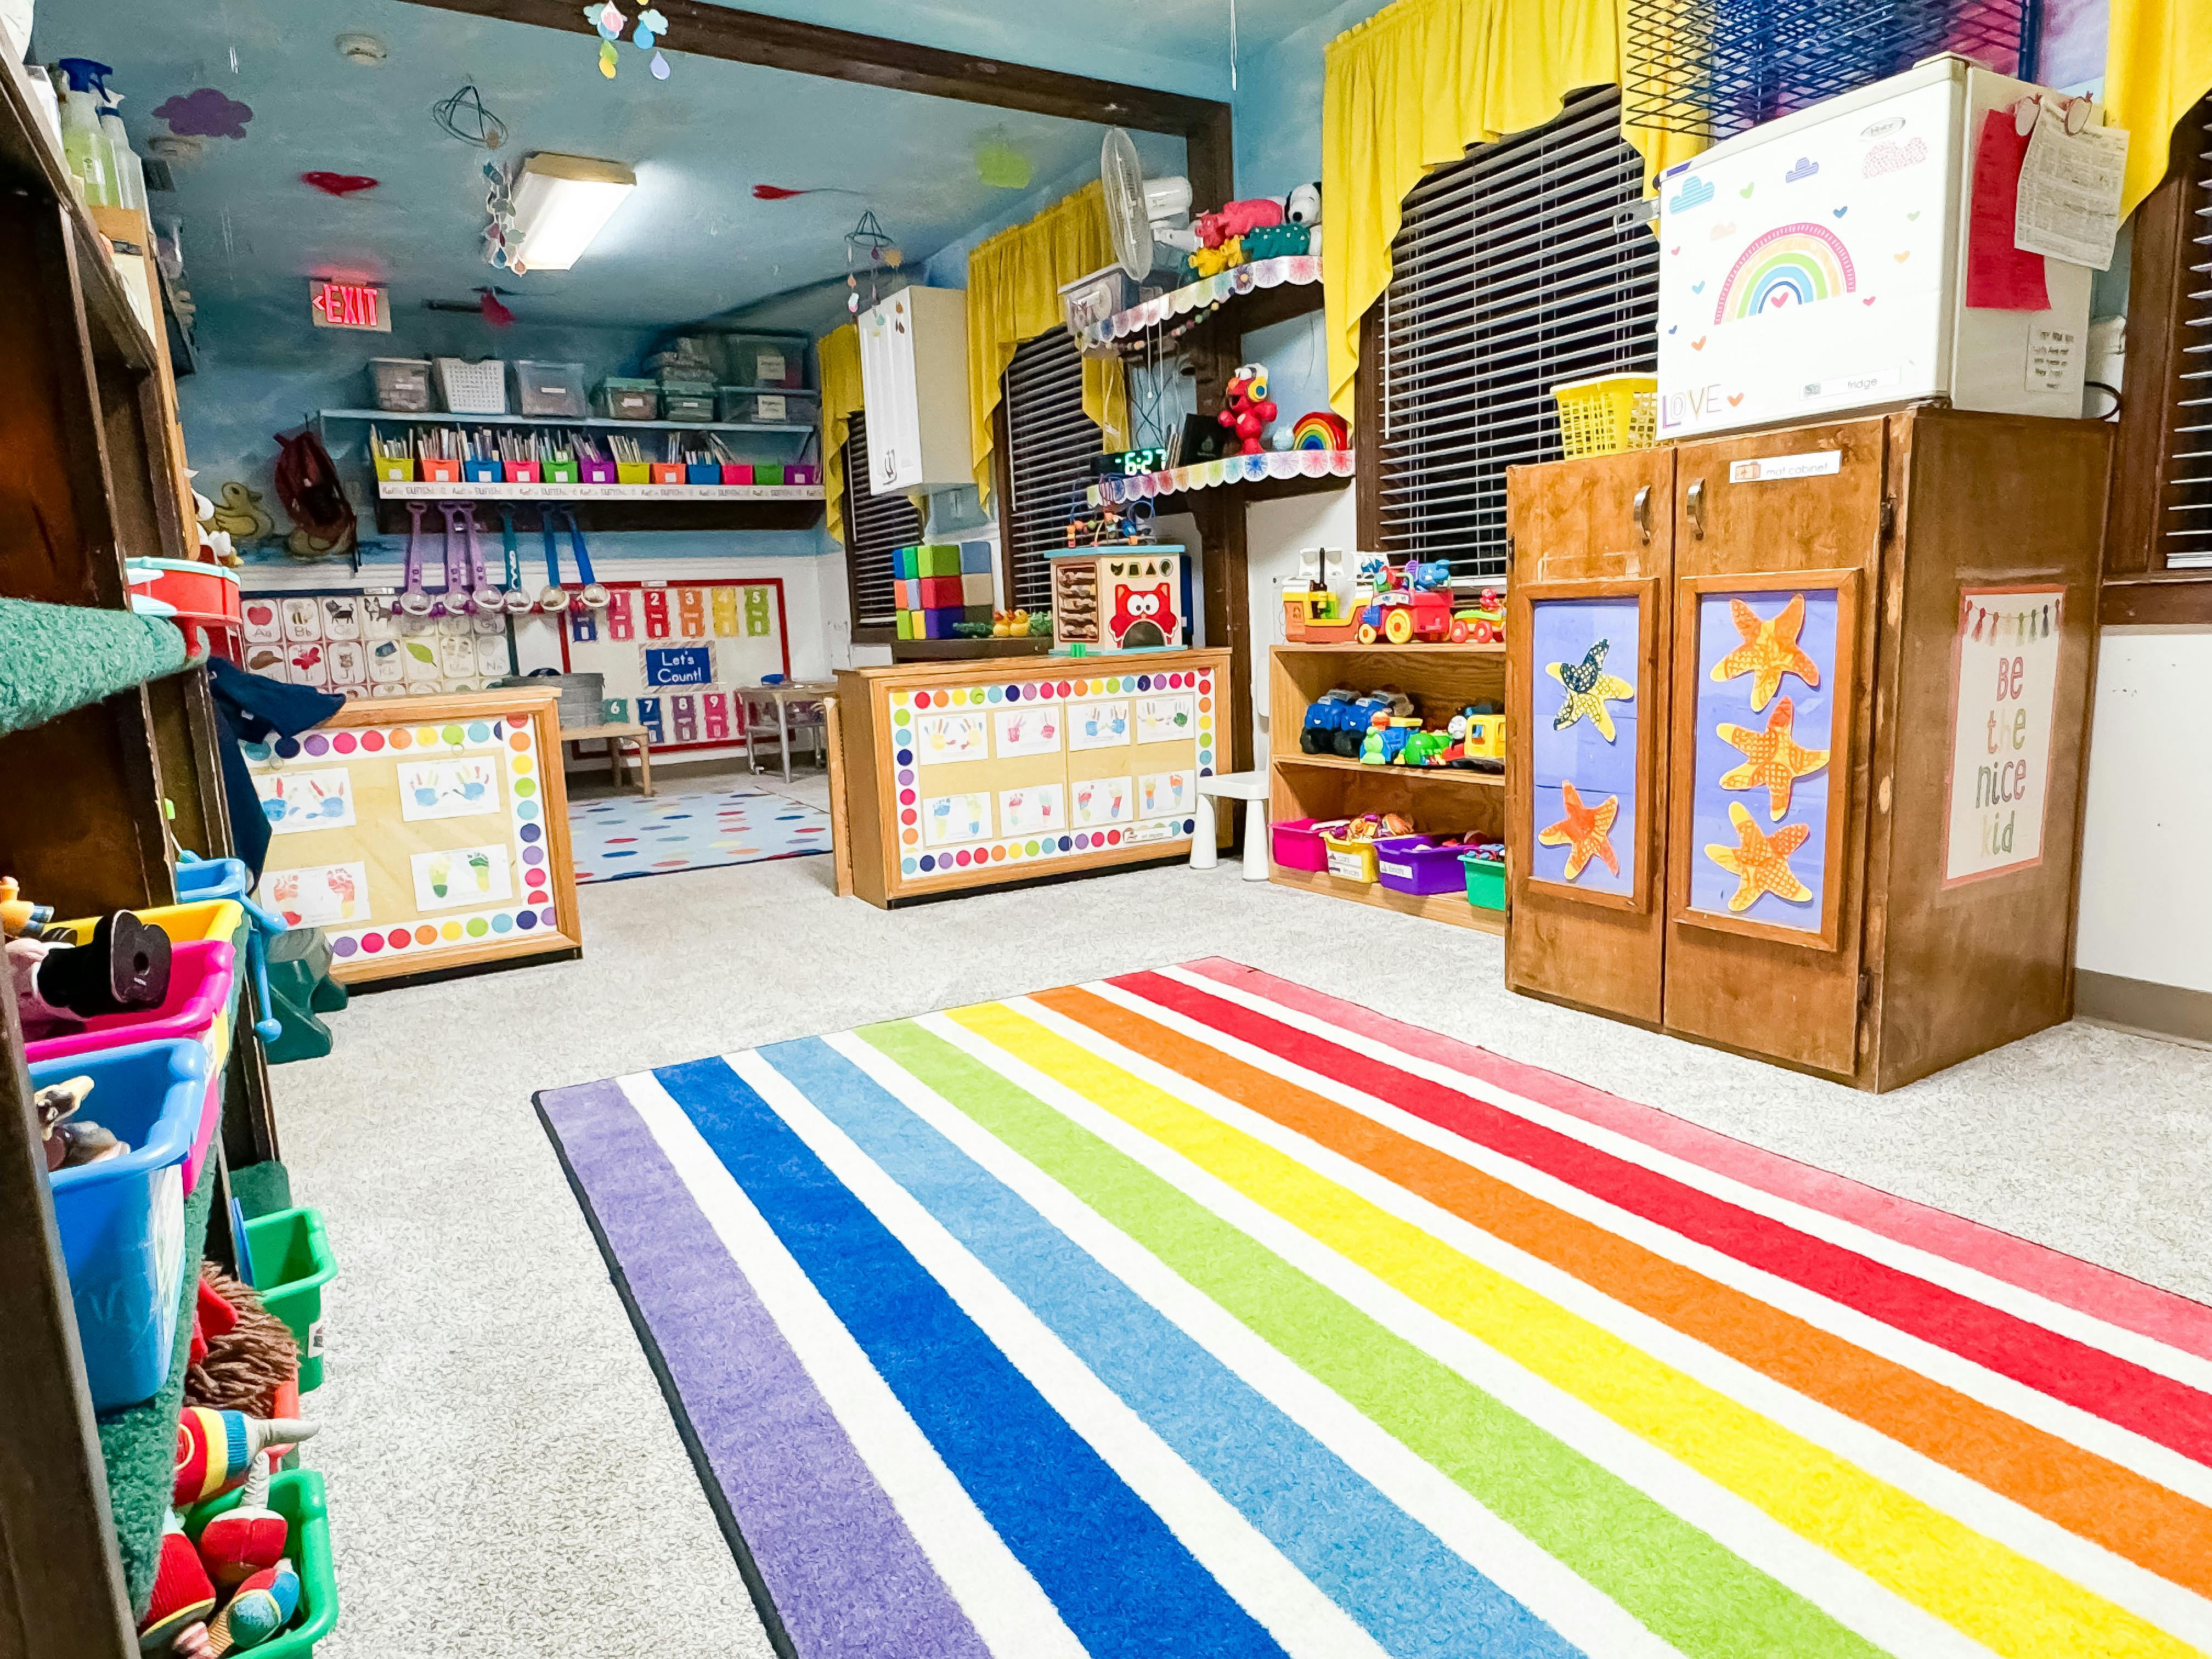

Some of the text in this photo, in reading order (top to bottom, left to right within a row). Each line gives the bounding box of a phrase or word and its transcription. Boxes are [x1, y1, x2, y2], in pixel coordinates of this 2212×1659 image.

[323, 284, 377, 326] EXIT
[1847, 377, 1878, 390] fridge
[1662, 383, 1722, 429] LOVE
[1125, 449, 1166, 475] 6:27
[1788, 462, 1828, 475] cabinet
[650, 592, 659, 605] 2
[685, 592, 695, 605] 3
[752, 591, 761, 603] 5
[662, 650, 695, 666] Let's
[657, 667, 702, 684] Count!
[610, 701, 620, 714] 6
[644, 699, 653, 713] 7
[678, 697, 688, 710] 8
[709, 695, 719, 707] 9
[1986, 708, 2026, 754] the
[1975, 758, 2027, 809] nice
[1980, 810, 2016, 857] kid
